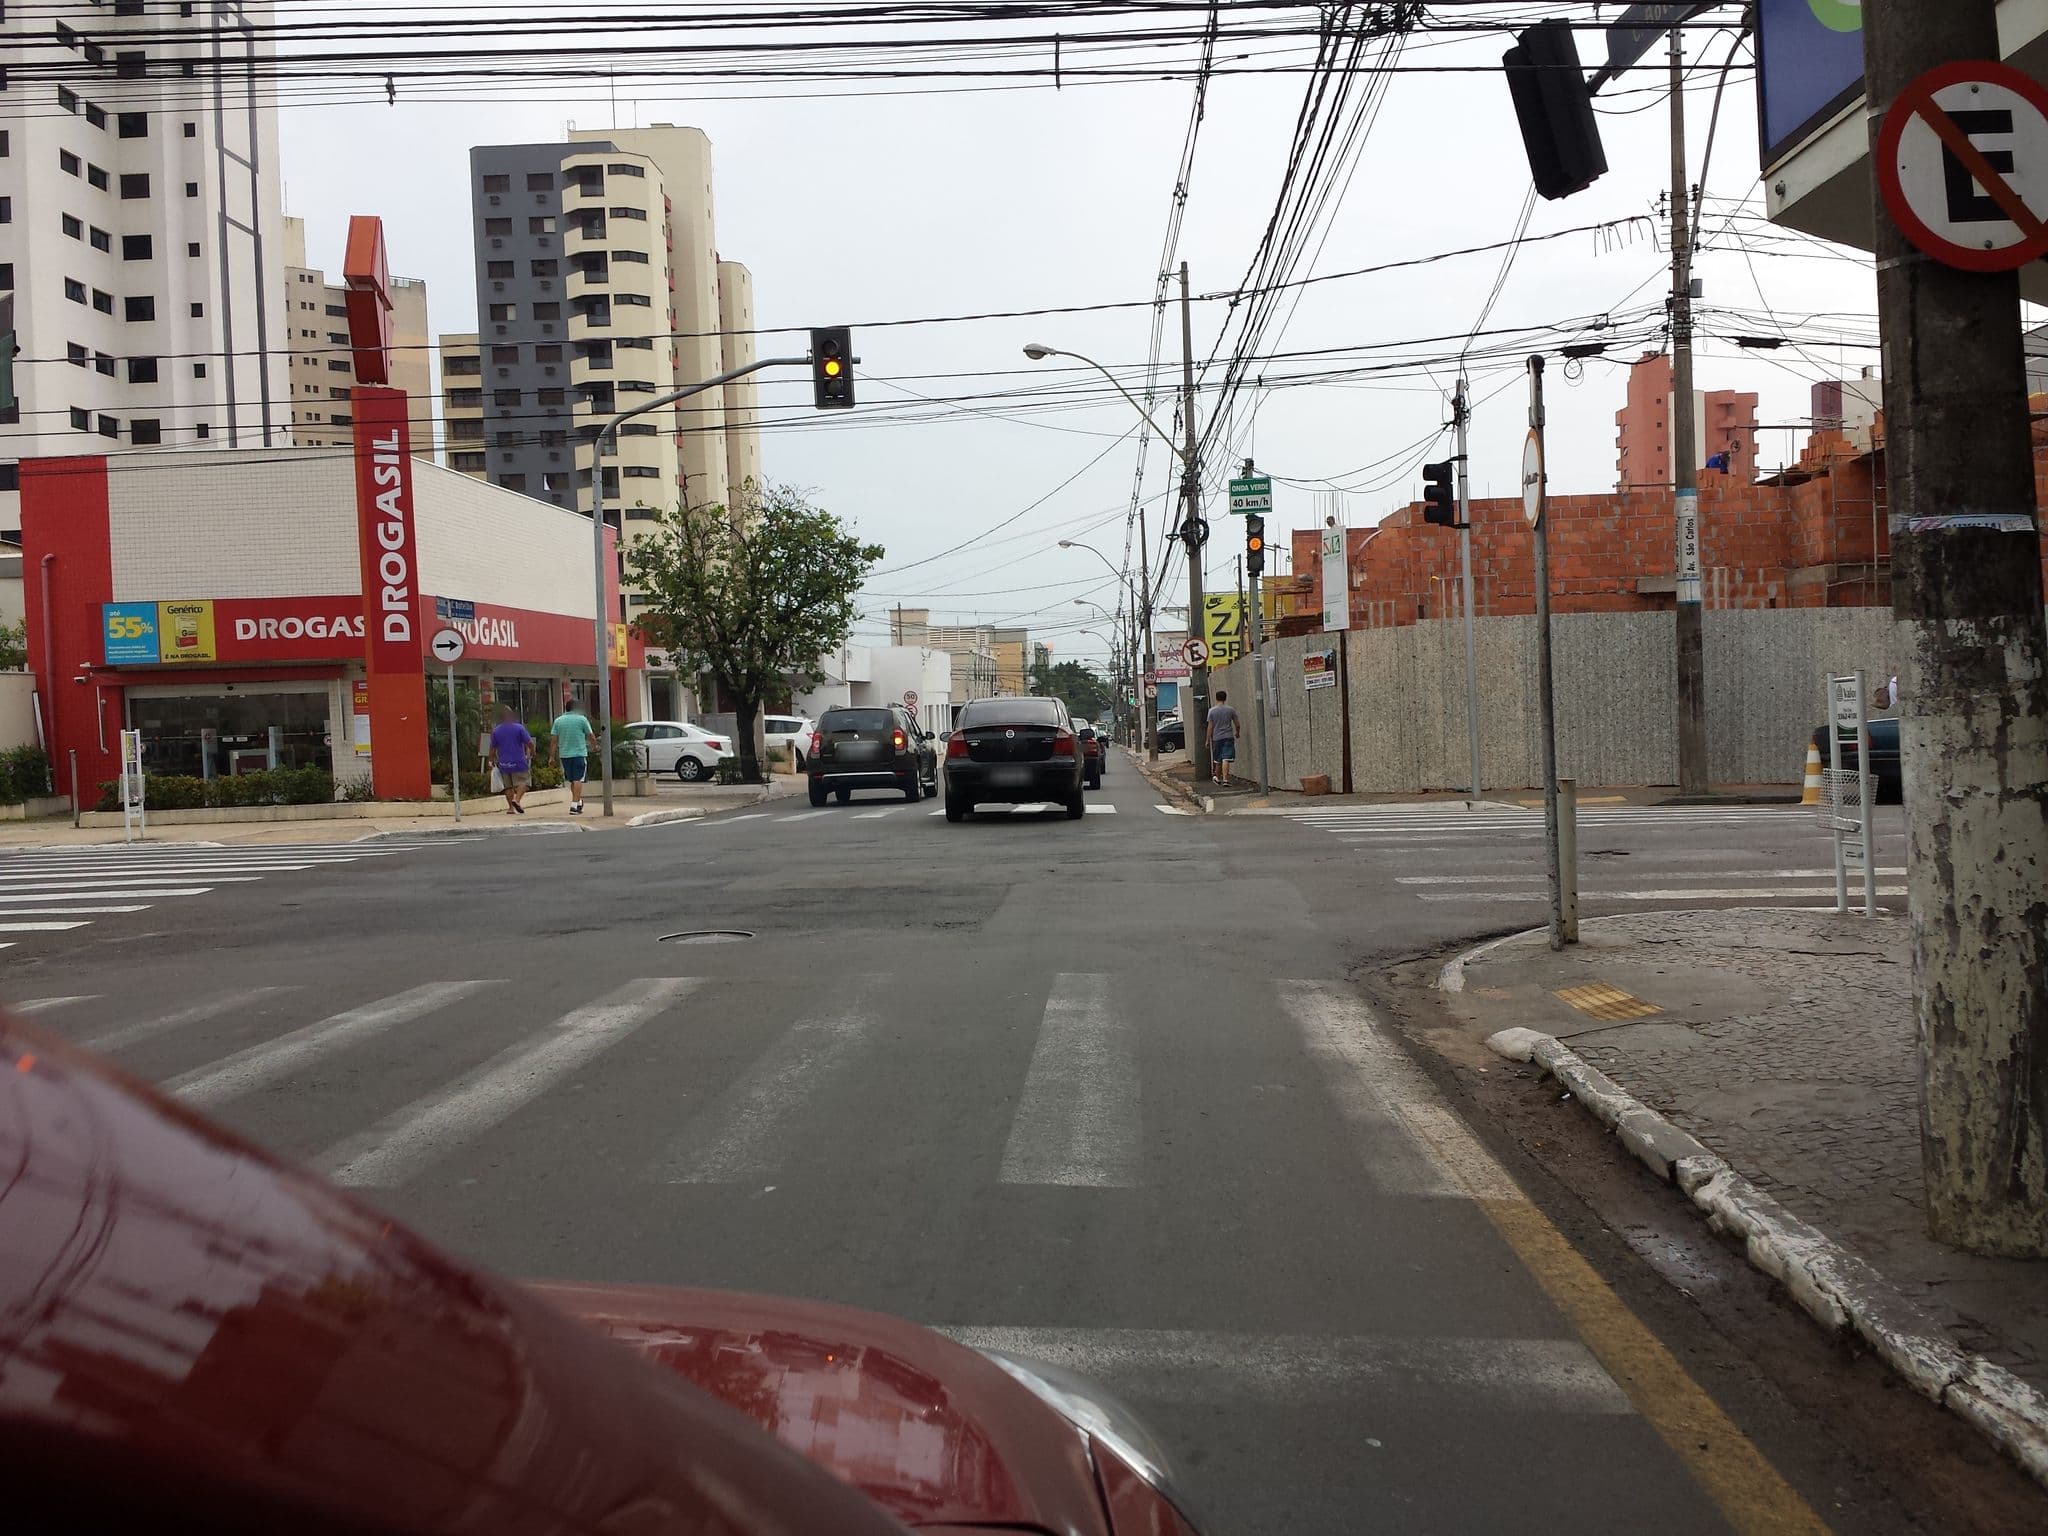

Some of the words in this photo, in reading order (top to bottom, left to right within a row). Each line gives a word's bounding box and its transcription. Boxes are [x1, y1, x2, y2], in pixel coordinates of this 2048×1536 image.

[1232, 498, 1244, 508] 40
[1245, 497, 1269, 508] km/h
[372, 428, 411, 642] DROGASIL
[1685, 518, 1695, 540] Carlos
[167, 605, 204, 615] Genérico
[108, 616, 154, 639] 55%
[452, 616, 519, 648] ROGASIL
